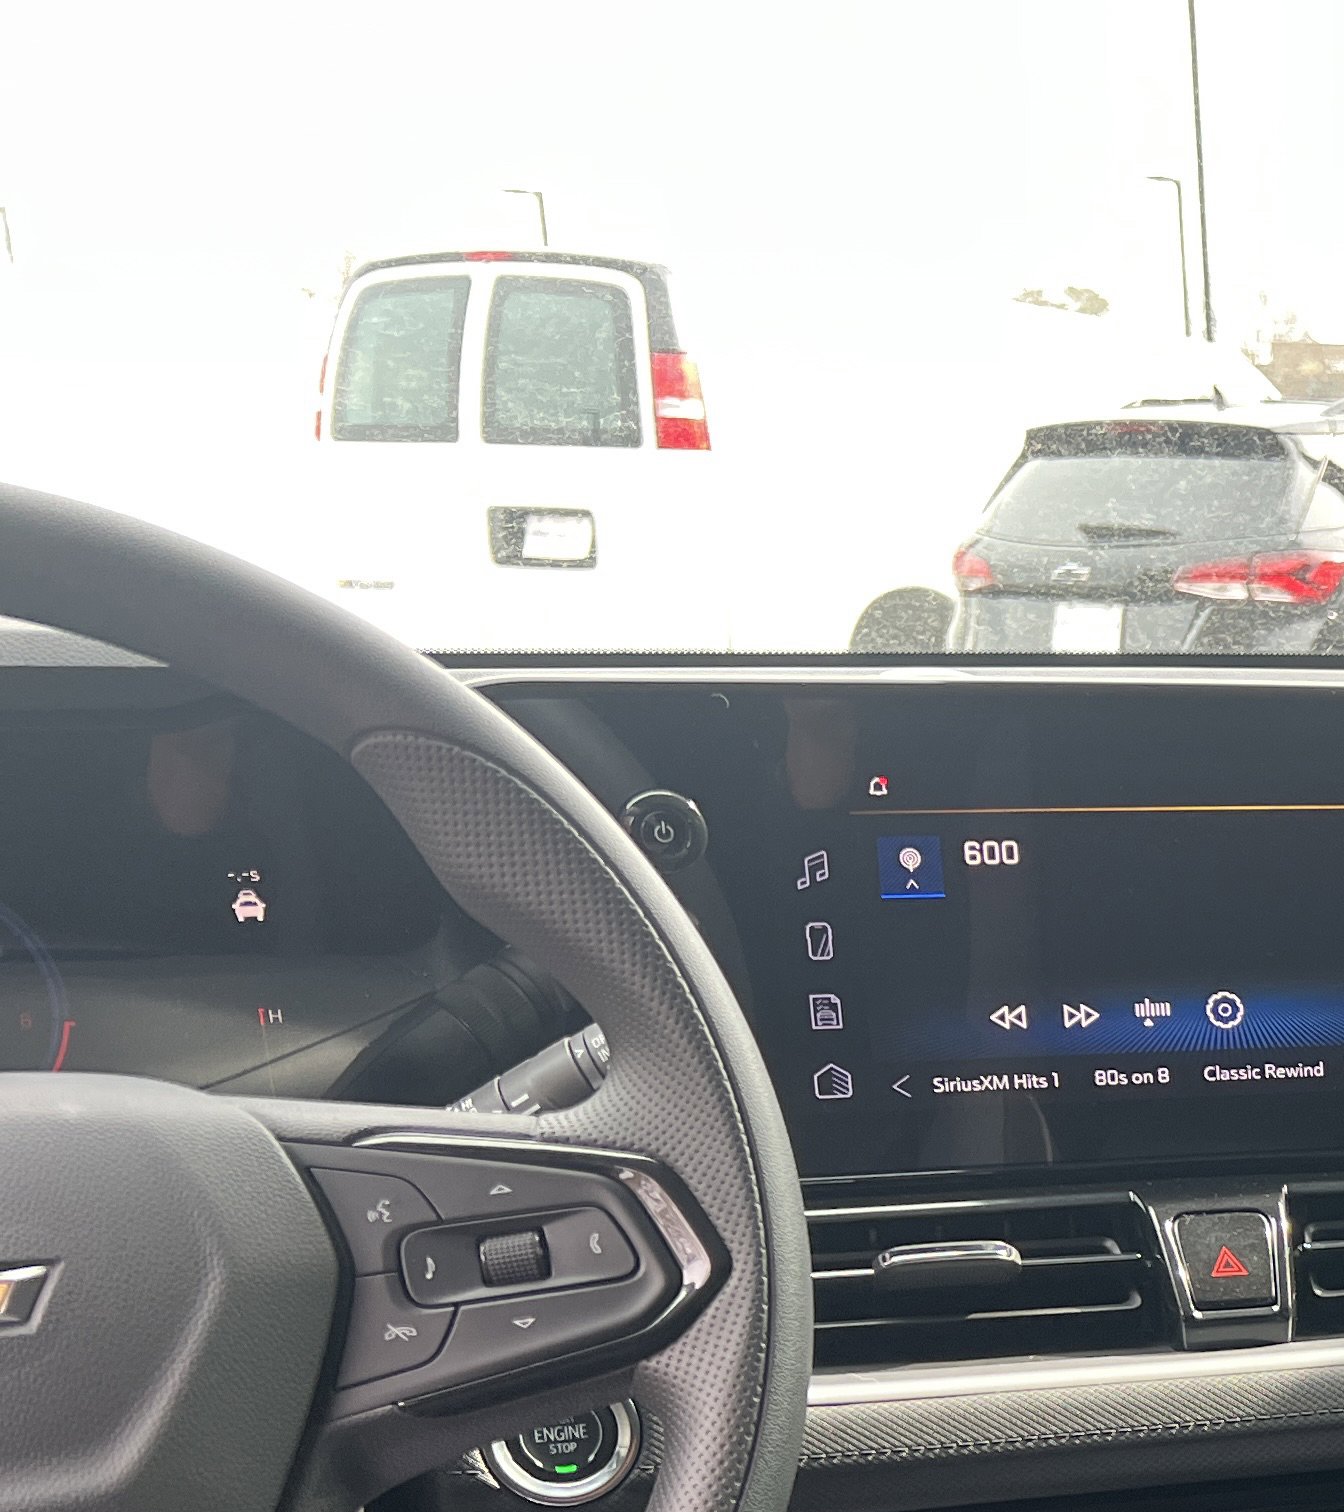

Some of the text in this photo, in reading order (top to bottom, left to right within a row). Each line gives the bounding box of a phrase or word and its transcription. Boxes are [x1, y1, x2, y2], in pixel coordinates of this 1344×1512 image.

[963, 839, 1020, 865] 600
[268, 1008, 283, 1024] H
[932, 1071, 1060, 1093] SiriusXM Hits 1
[1093, 1066, 1171, 1087] 80s on 8
[1203, 1061, 1325, 1082] Classic Rewind
[533, 1423, 589, 1443] ENGINE
[549, 1442, 578, 1455] STOP
